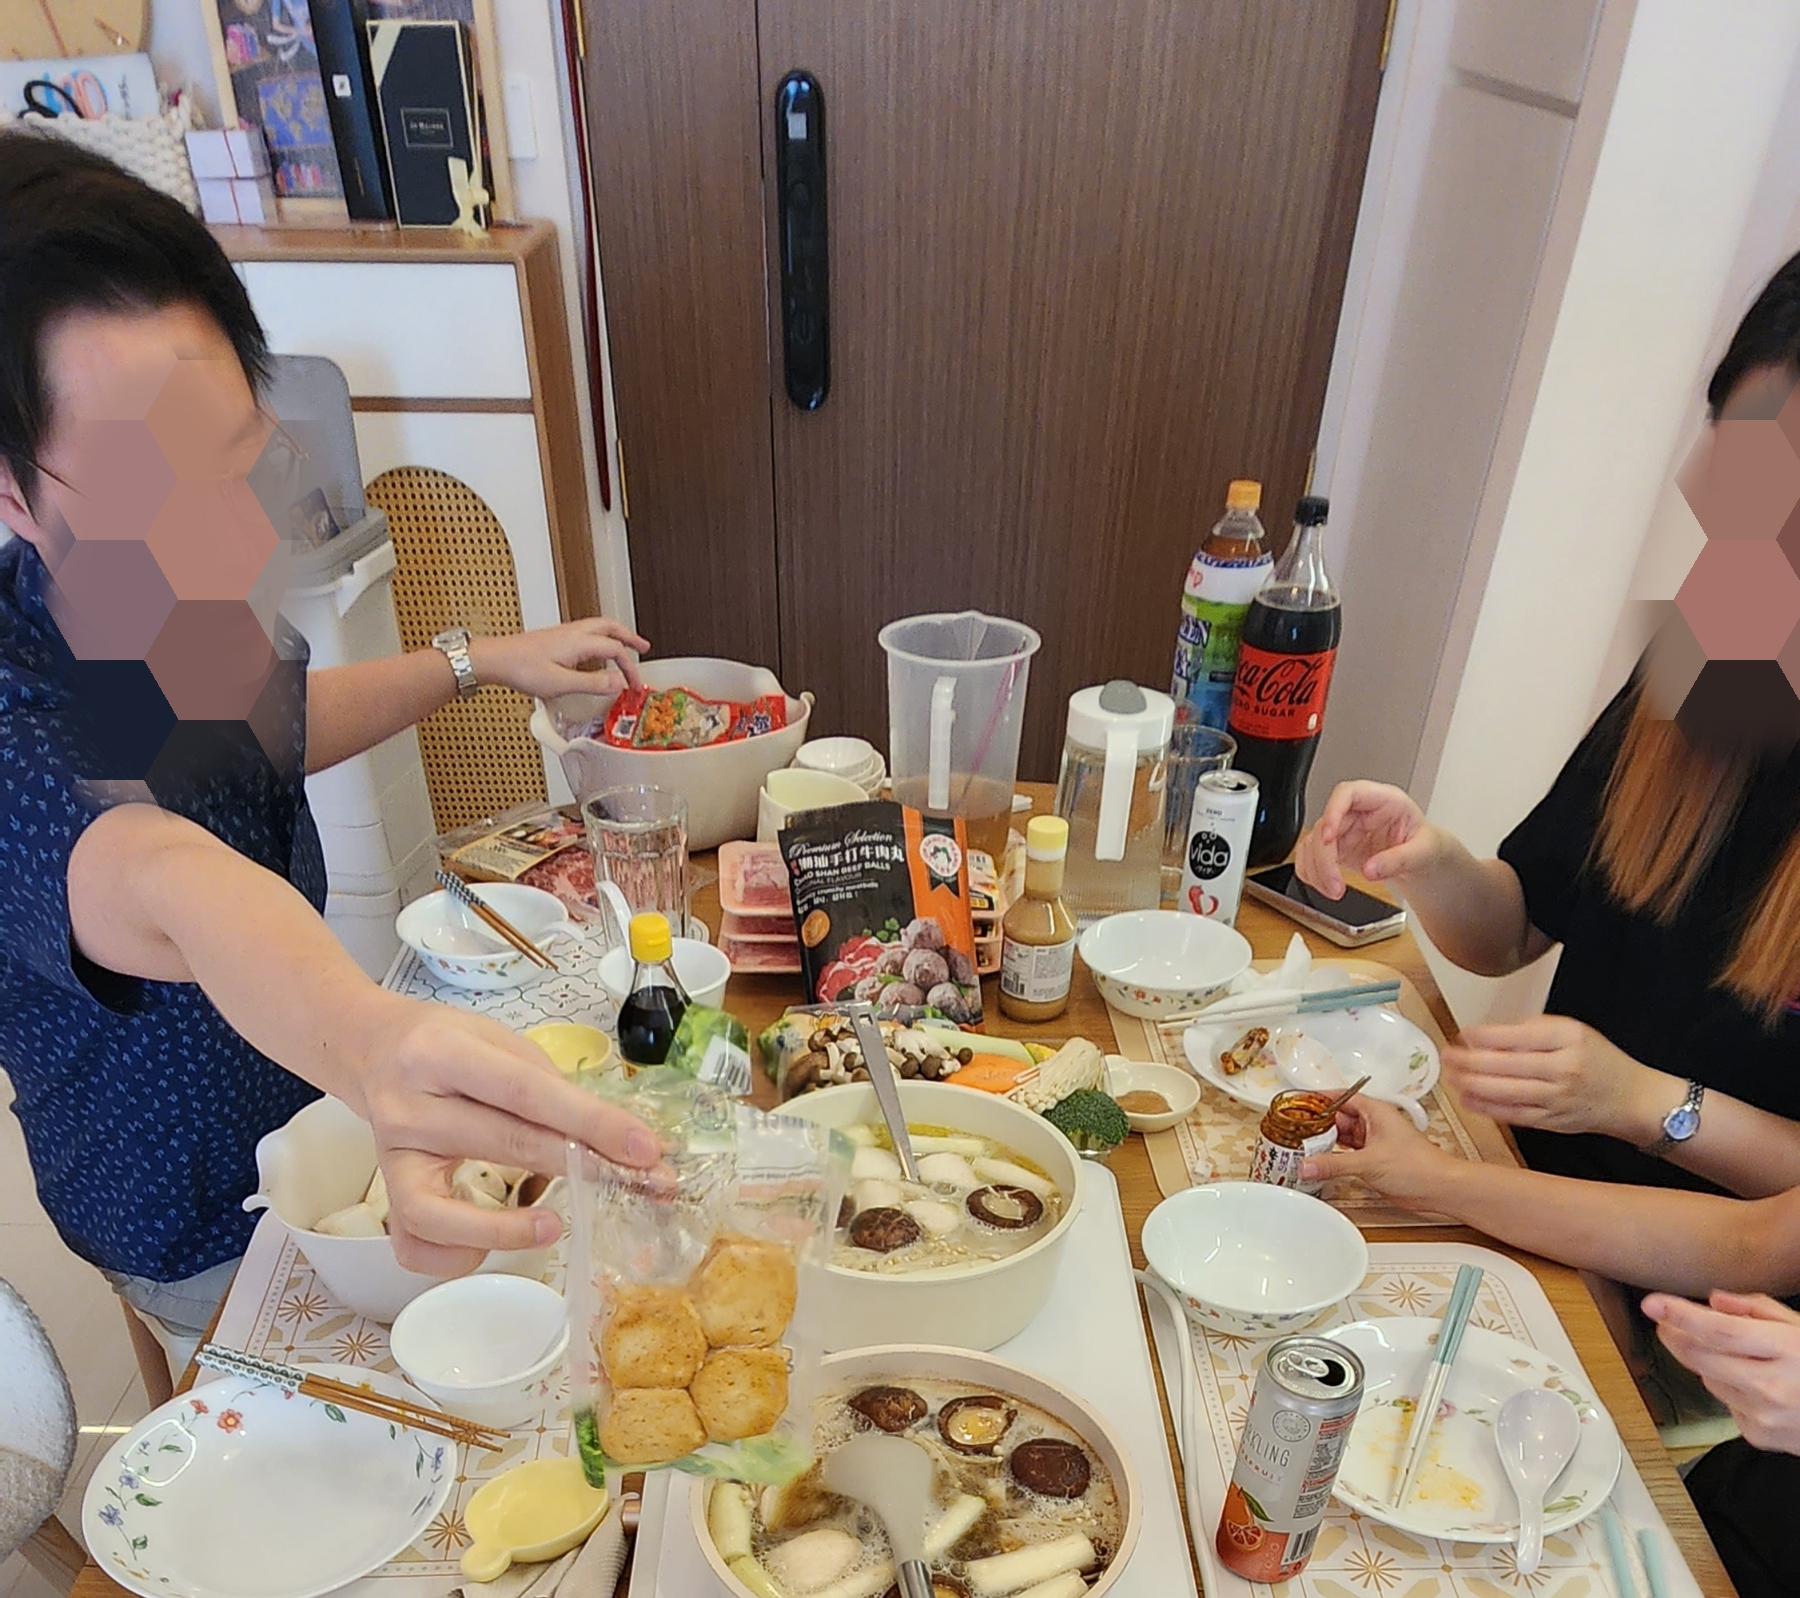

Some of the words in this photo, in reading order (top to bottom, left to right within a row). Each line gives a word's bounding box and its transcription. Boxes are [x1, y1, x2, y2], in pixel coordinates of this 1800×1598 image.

[1254, 705, 1296, 717] SUGAR
[789, 841, 841, 859] Premium
[844, 829, 893, 847] Selection
[1190, 843, 1229, 867] vida
[815, 867, 840, 878] SHAN
[841, 862, 863, 875] BEEF
[864, 861, 891, 872] BALLS
